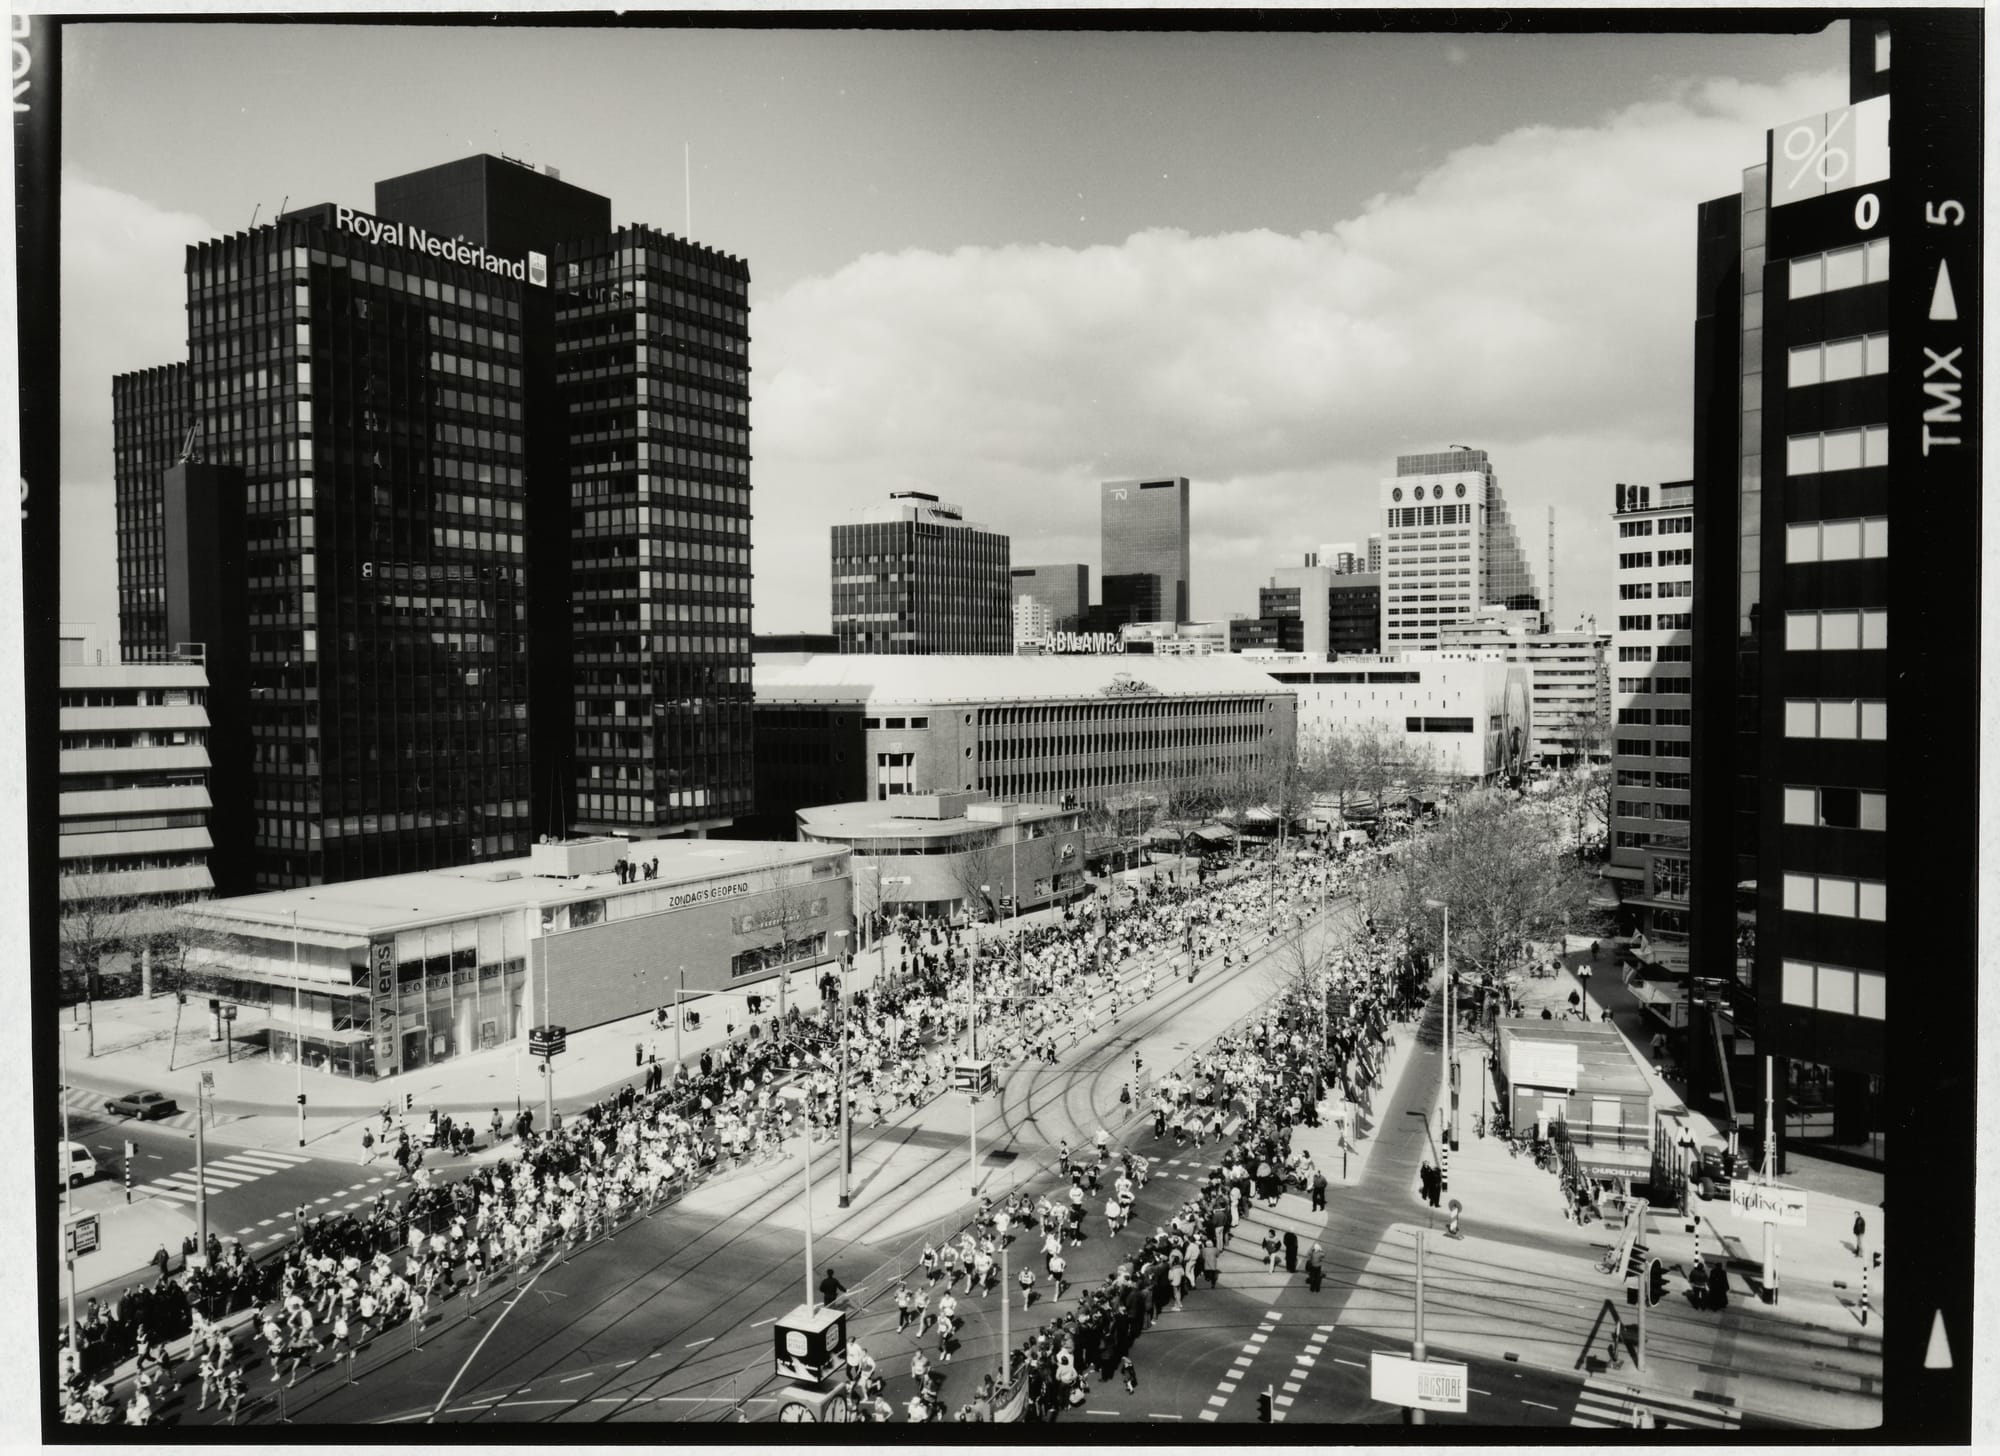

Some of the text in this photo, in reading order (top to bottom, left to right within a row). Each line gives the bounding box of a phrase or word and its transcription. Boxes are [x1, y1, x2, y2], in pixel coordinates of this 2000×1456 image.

[336, 204, 525, 281] Royal Nederland
[1922, 200, 1966, 457] TMX 5
[1045, 631, 1076, 653] ABN
[669, 882, 748, 907] ZONDAG'S GEOPEND
[374, 945, 393, 1002] lens
